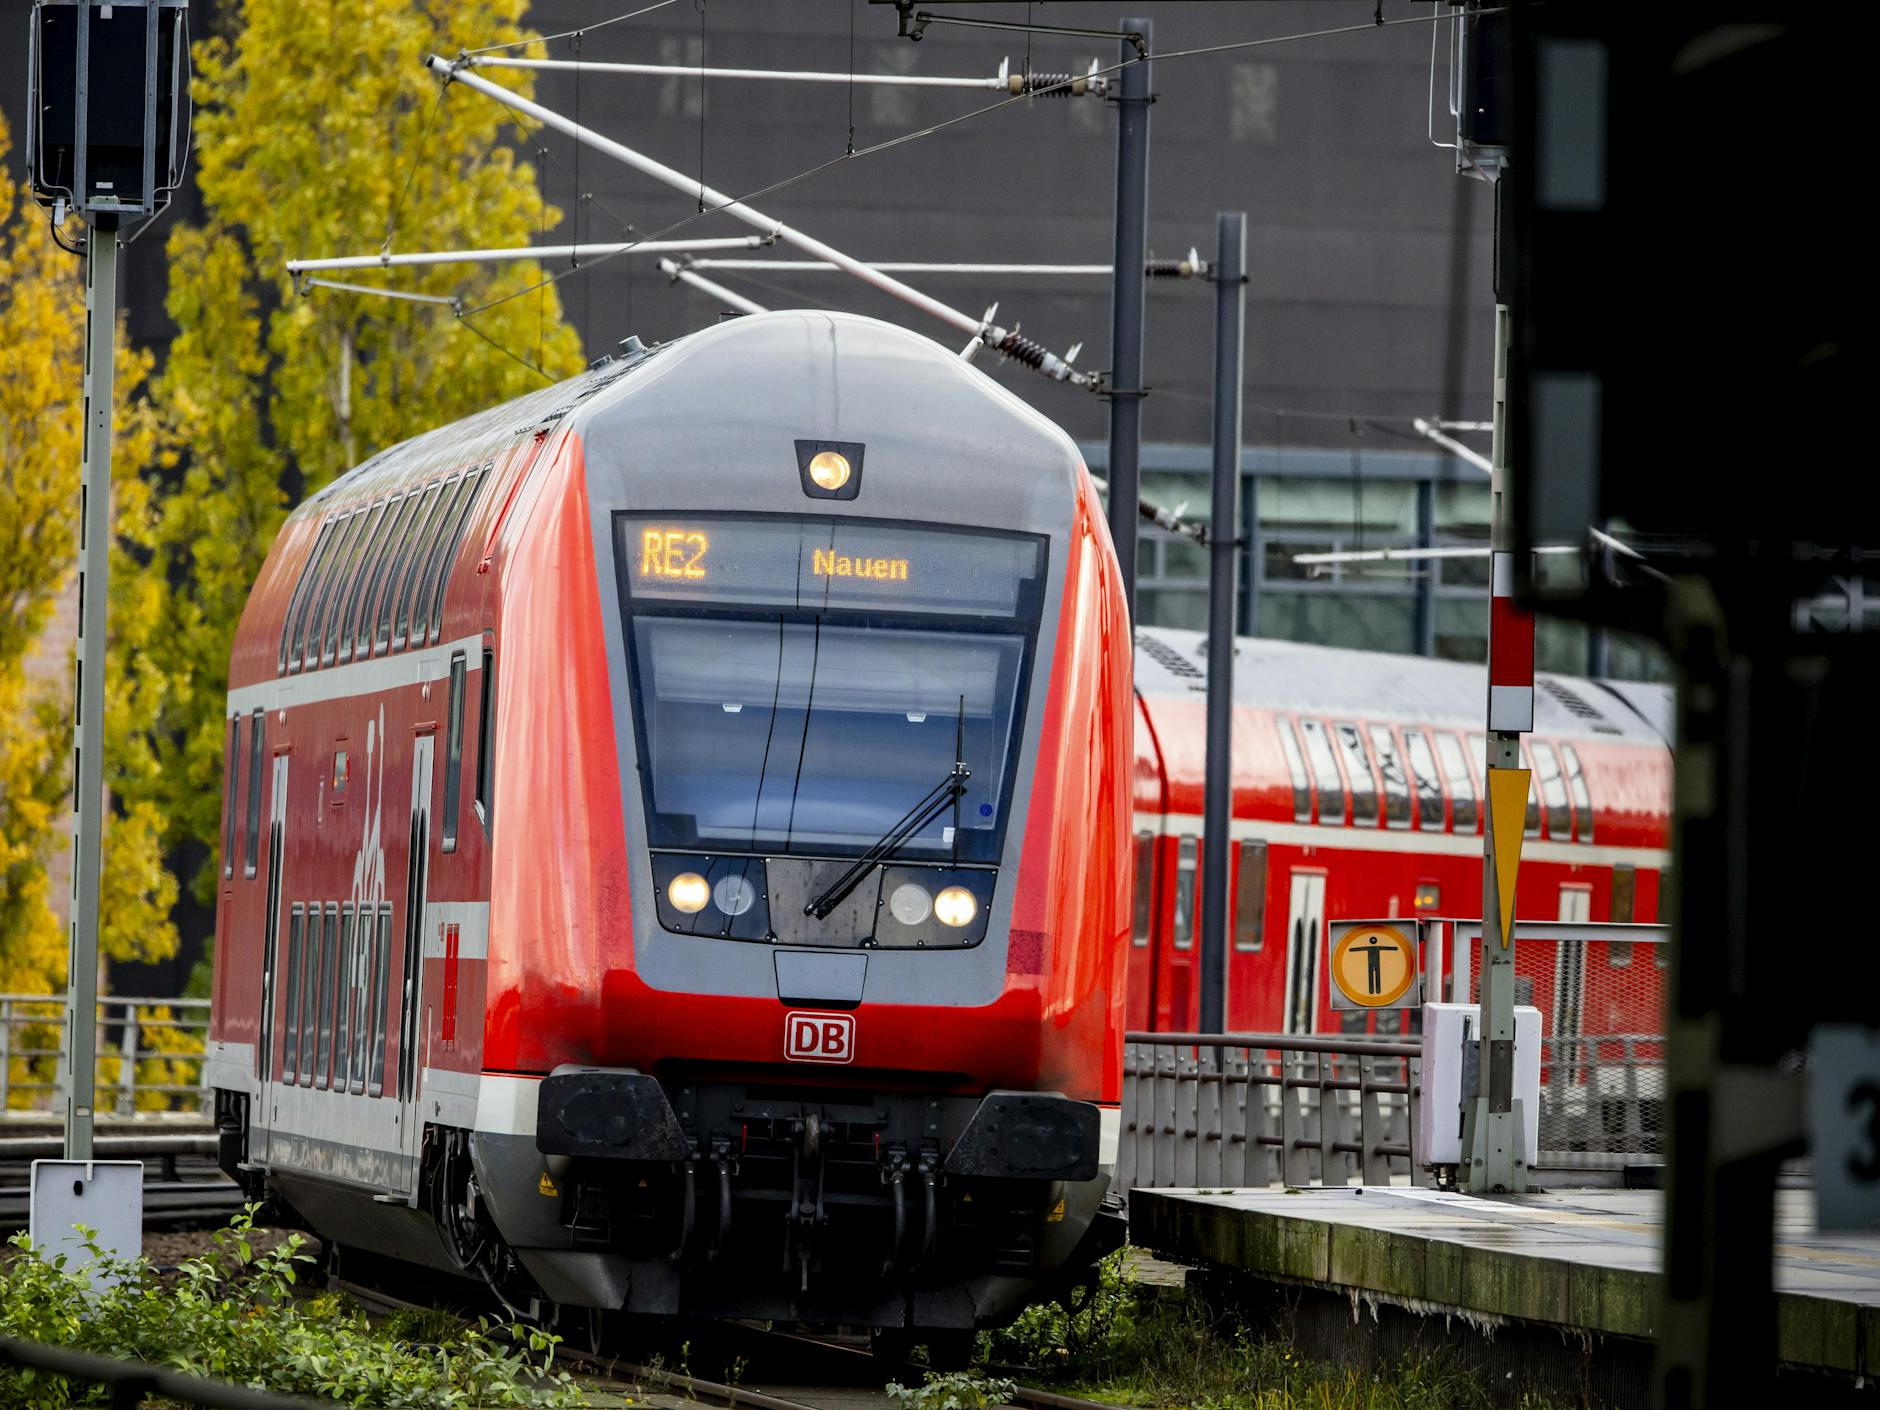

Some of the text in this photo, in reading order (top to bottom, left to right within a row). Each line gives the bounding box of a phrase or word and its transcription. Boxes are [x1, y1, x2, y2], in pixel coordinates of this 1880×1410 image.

[641, 528, 910, 582] RE2 Nauen
[792, 1020, 846, 1055] DB
